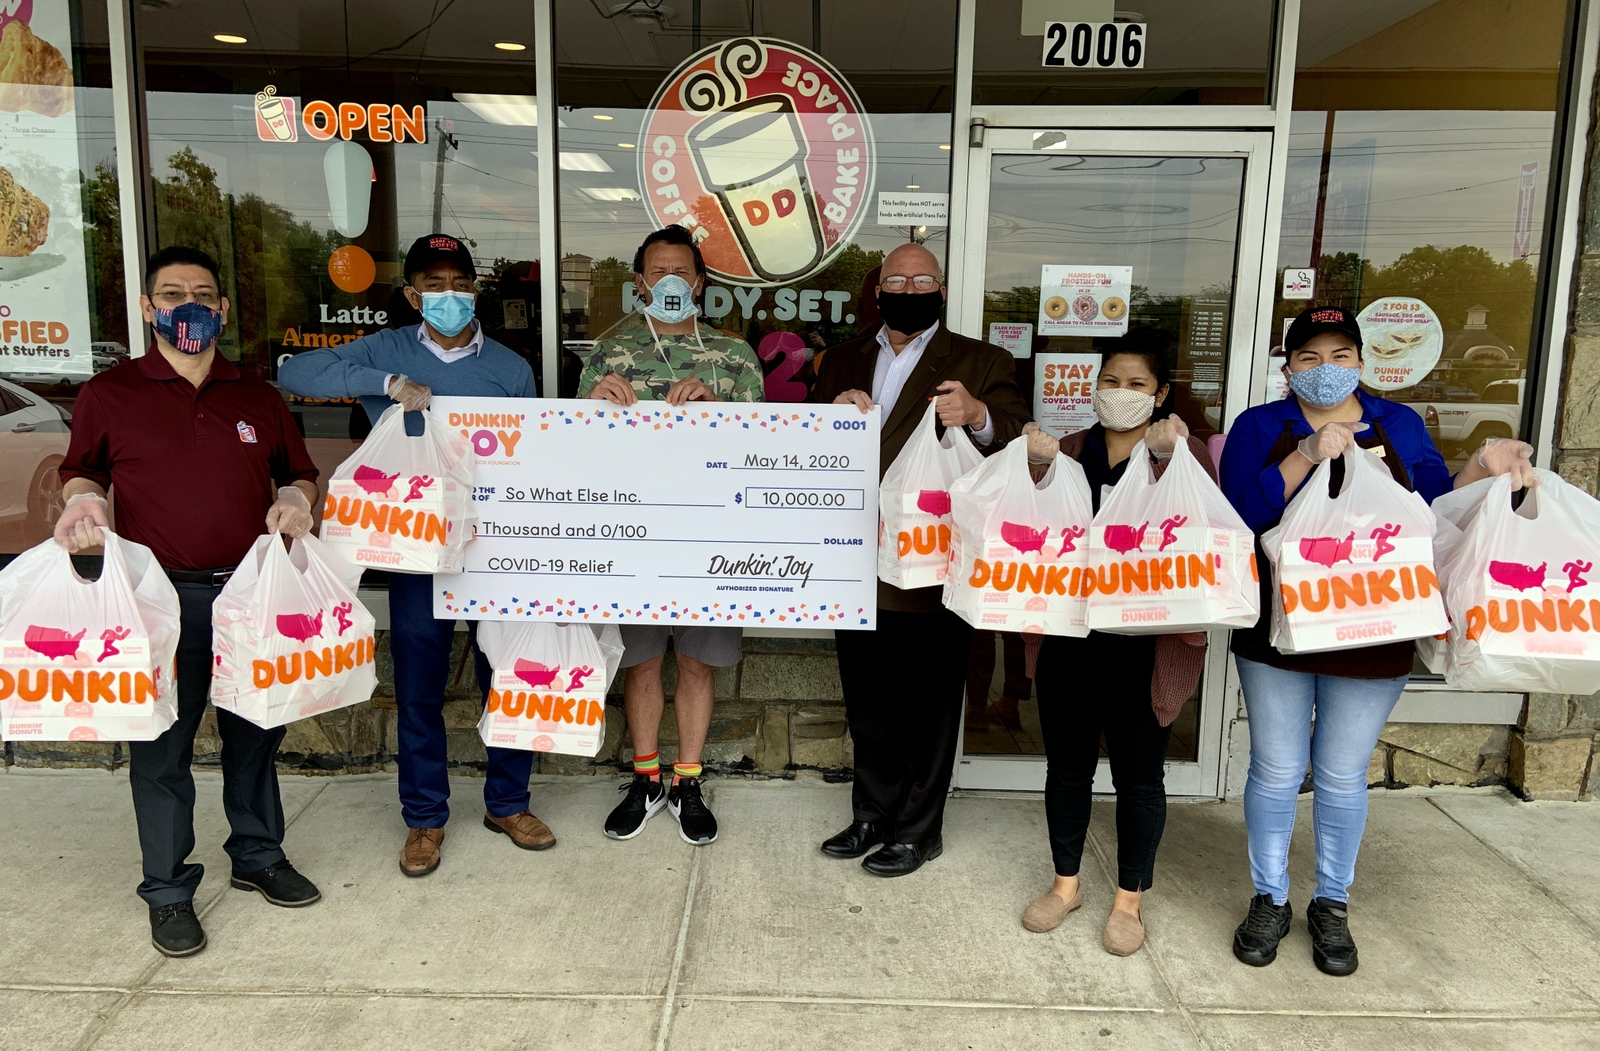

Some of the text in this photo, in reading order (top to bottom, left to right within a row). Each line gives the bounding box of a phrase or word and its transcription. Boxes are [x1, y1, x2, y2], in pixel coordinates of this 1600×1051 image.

[1045, 23, 1142, 68] 2006
[302, 100, 426, 144] OPEN
[782, 61, 860, 224] BAKE PLACE
[742, 188, 797, 226] DD
[621, 281, 768, 321] RDY.
[319, 304, 388, 325] Latte
[0, 320, 69, 344] FIED
[13, 346, 70, 357] Stuffers
[1044, 364, 1093, 379] STAY
[1374, 367, 1413, 375] DUNKIN'
[1043, 381, 1092, 397] SAFE
[448, 413, 525, 428] DUNKIN'
[833, 420, 866, 431] 0001
[744, 454, 778, 469] May
[783, 455, 803, 470] 14,
[809, 455, 850, 468] 2020
[506, 487, 642, 503] So What Else Inc.
[735, 492, 845, 507] $ 10,000.00
[483, 521, 560, 536] Thousand
[566, 524, 596, 537] and
[601, 525, 647, 539] 0/100
[356, 552, 403, 565] DUNKIN'
[488, 558, 613, 573] COVID-19 Relief
[779, 556, 814, 588] Joy
[1080, 552, 1221, 597] DUNKIN'
[1122, 611, 1170, 622] DUNKIN'
[1336, 625, 1397, 641] DUNKIN'
